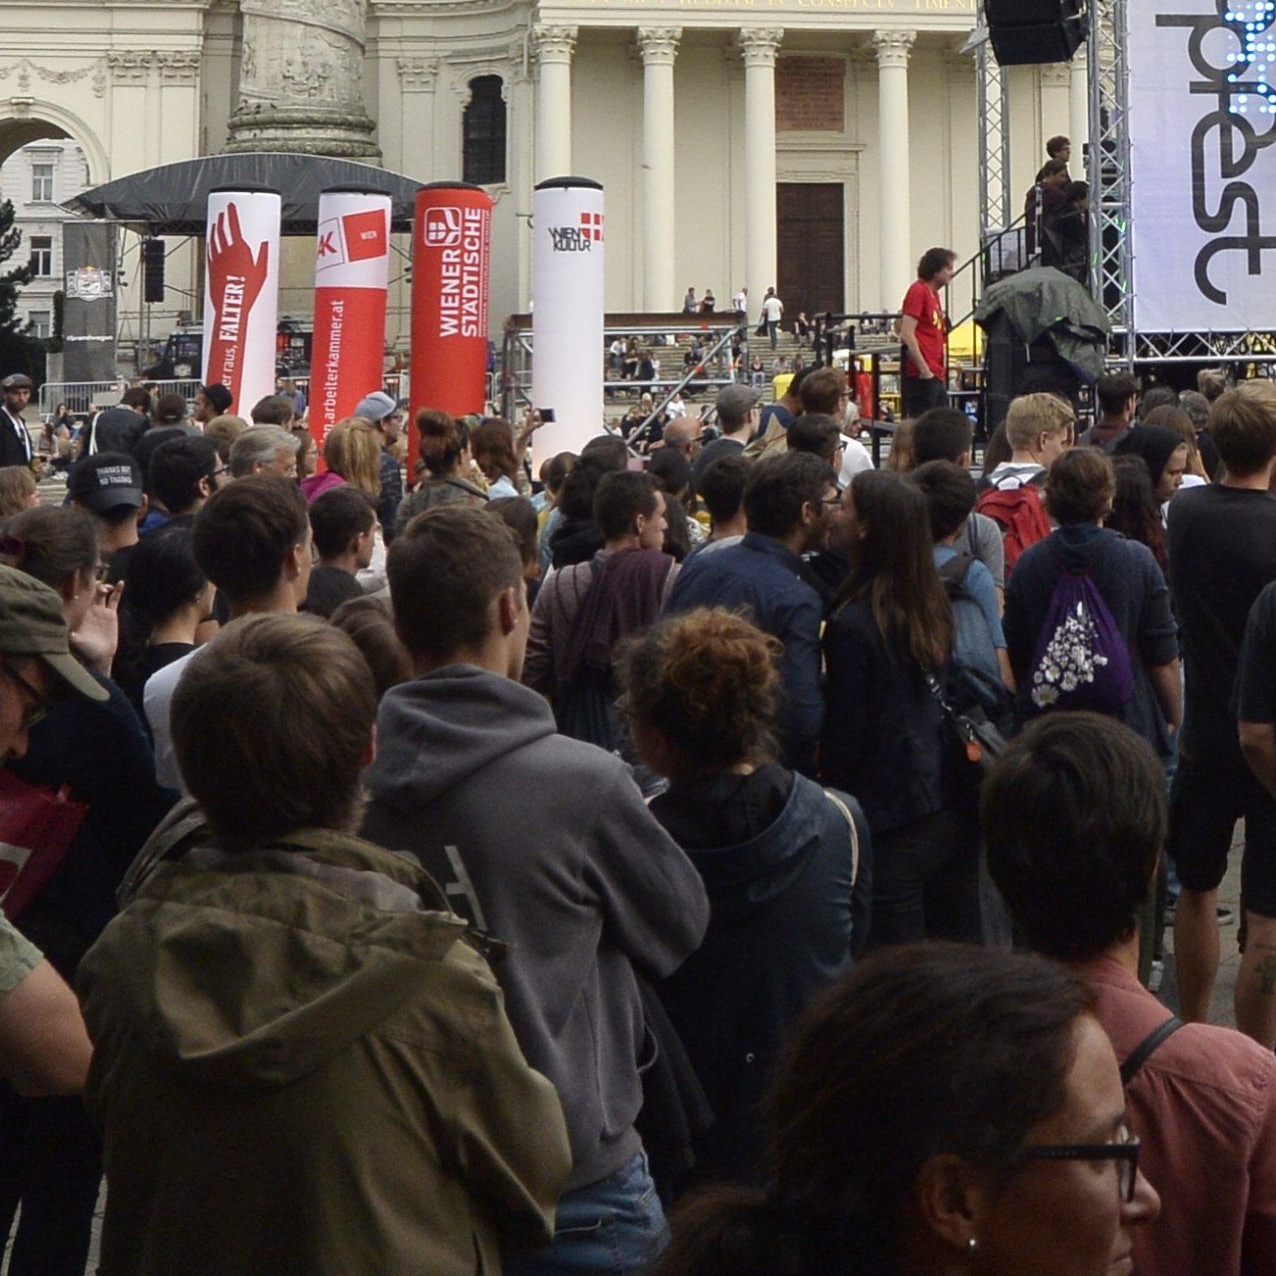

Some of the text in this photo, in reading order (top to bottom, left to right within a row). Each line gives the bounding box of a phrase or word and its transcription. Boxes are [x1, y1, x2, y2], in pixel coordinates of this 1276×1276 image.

[548, 227, 581, 240] WIEN
[553, 238, 591, 252] KULTUR
[439, 248, 461, 338] WIENER
[461, 207, 481, 338] STÄDTISCHE
[219, 275, 246, 342] FALTER!
